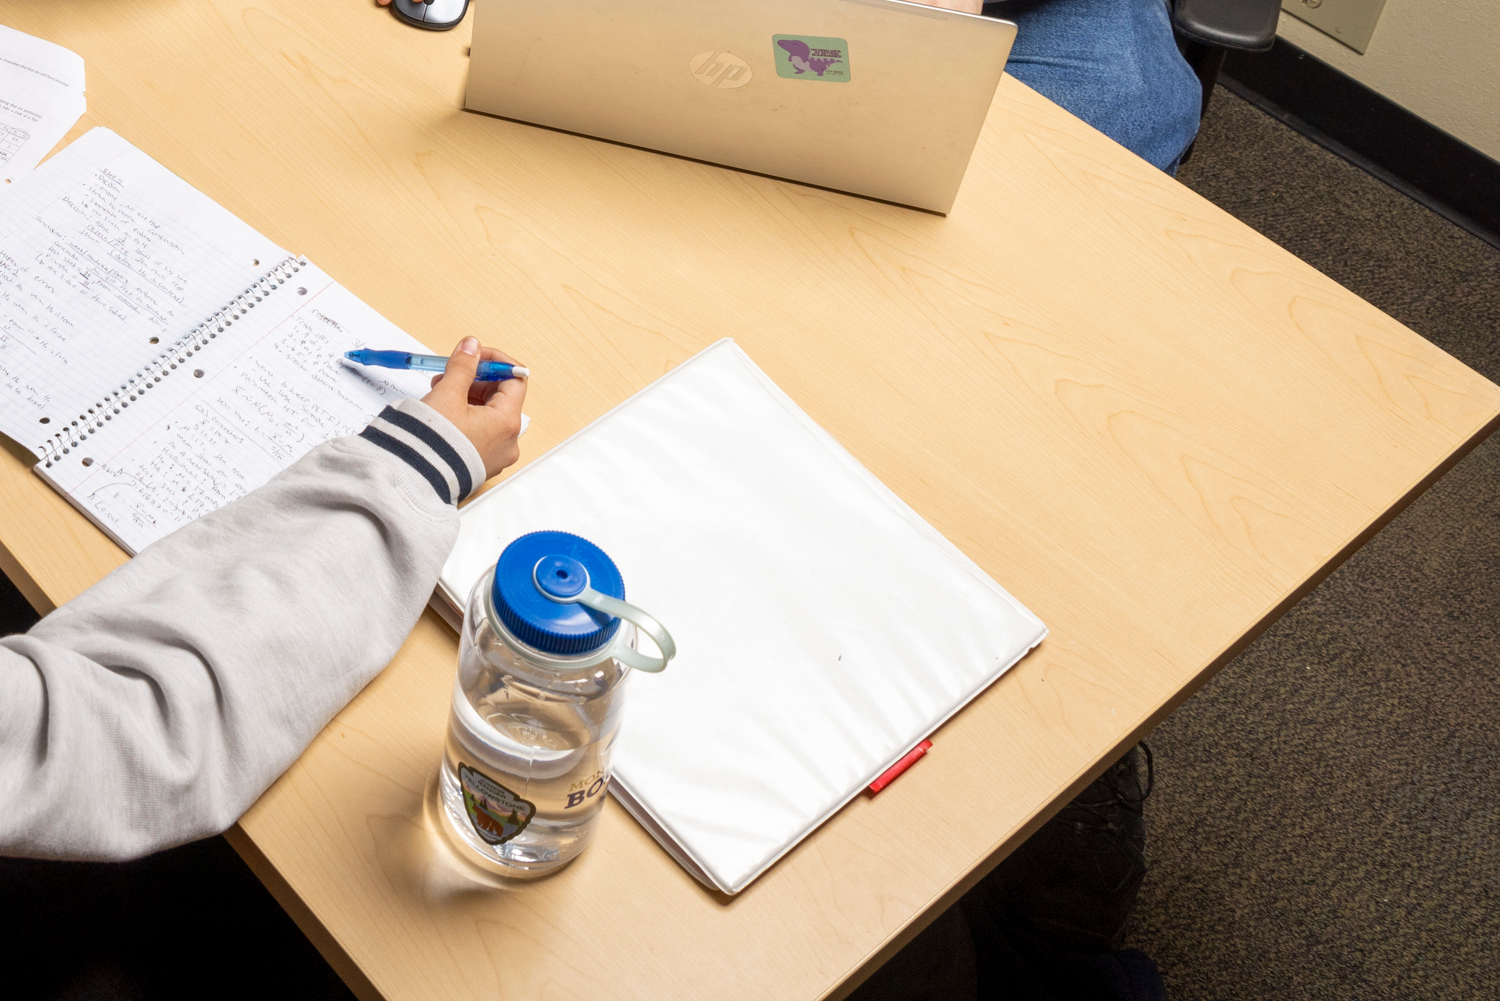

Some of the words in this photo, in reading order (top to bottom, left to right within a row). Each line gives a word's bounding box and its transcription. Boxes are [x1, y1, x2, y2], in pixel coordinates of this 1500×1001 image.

[696, 51, 750, 88] hp
[97, 174, 121, 194] Decision
[61, 195, 92, 220] Decision:
[19, 264, 30, 274] of
[32, 274, 56, 293] errors
[464, 773, 526, 812] YELLOWSTONE
[477, 780, 507, 800] RANGER
[479, 777, 506, 796] JUNIOR
